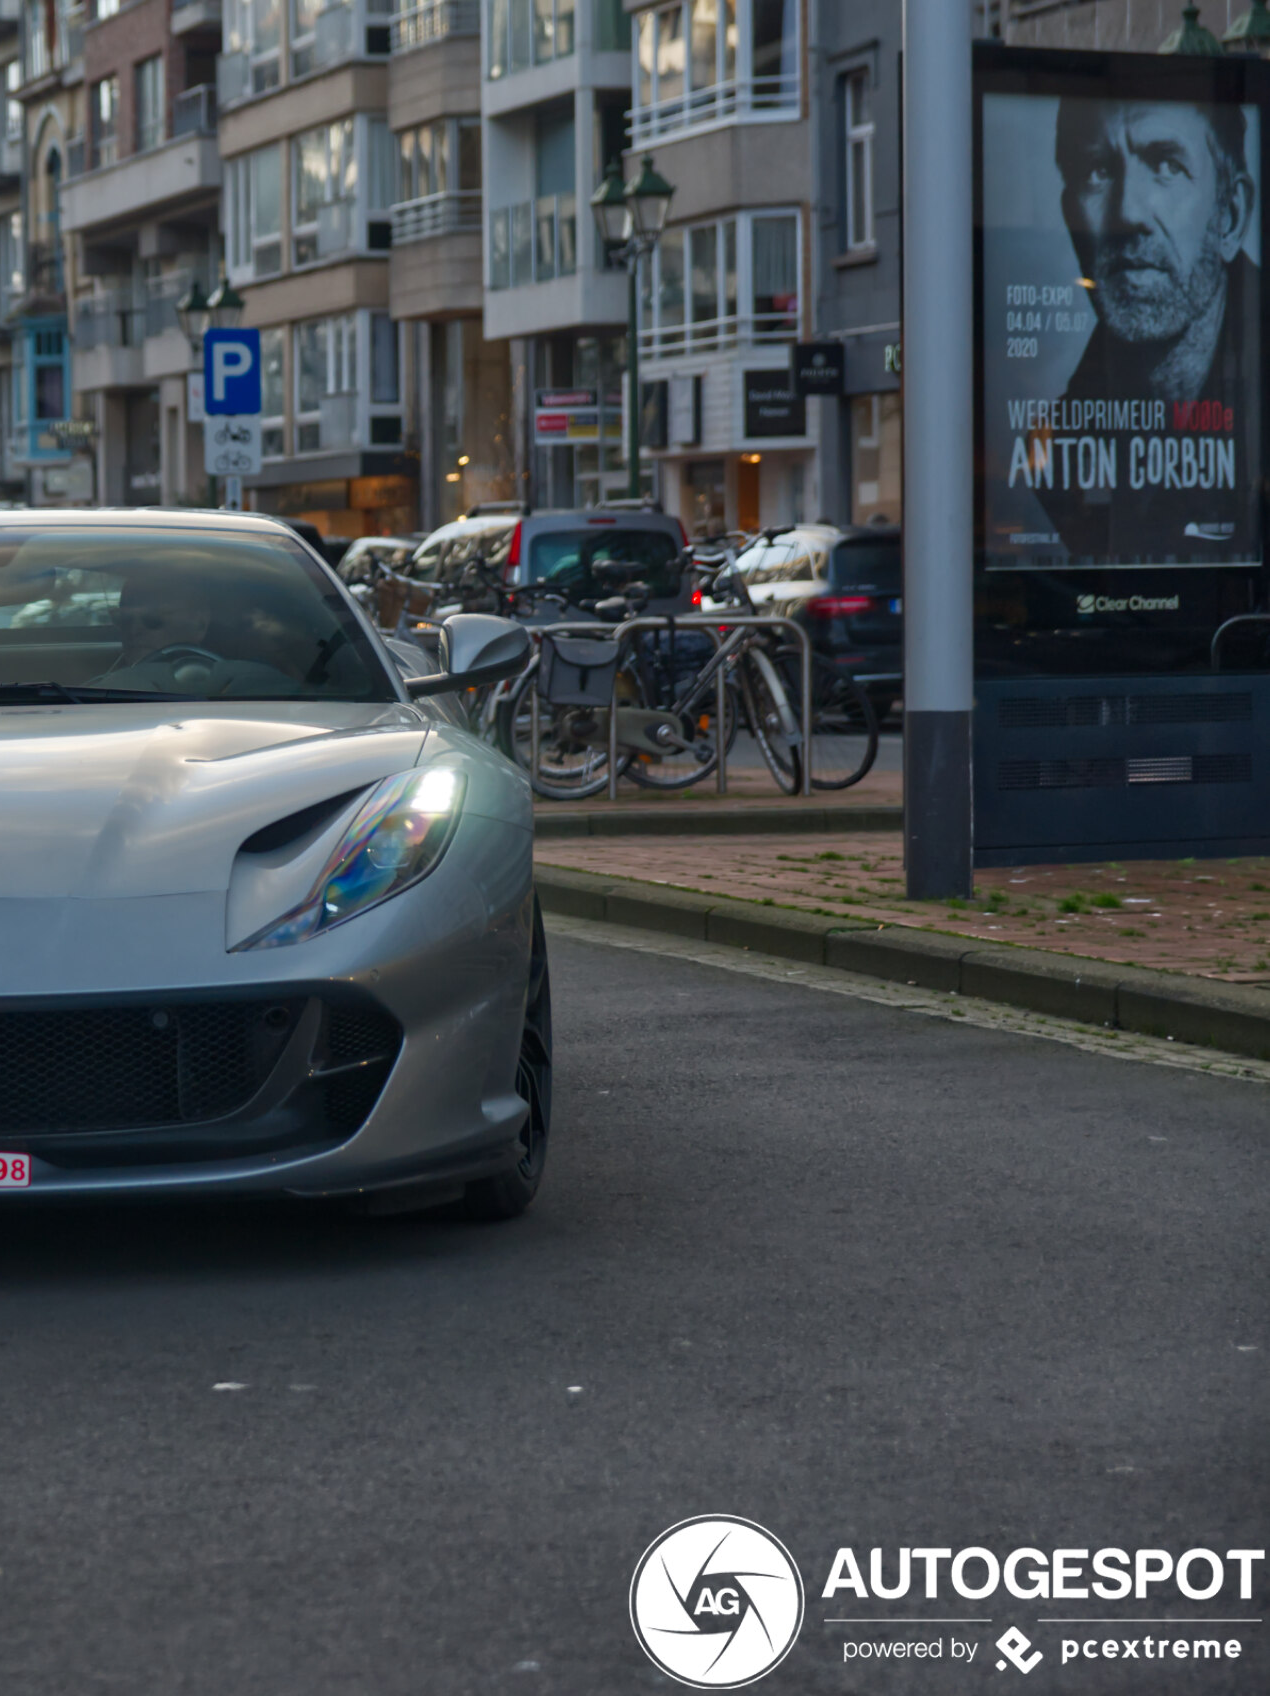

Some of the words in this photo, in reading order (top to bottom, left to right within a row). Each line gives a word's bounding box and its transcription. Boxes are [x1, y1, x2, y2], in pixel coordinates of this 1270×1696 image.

[1007, 285, 1073, 306] FOTO-EXPO
[1007, 311, 1041, 331] 04.04
[1045, 312, 1052, 332] /
[1007, 337, 1038, 358] 2020
[213, 341, 253, 401] P
[1008, 400, 1166, 430] WERELDPRIMEUR
[1008, 436, 1117, 490] ANTON
[1096, 595, 1127, 611] Clear
[1130, 594, 1179, 611] Channel
